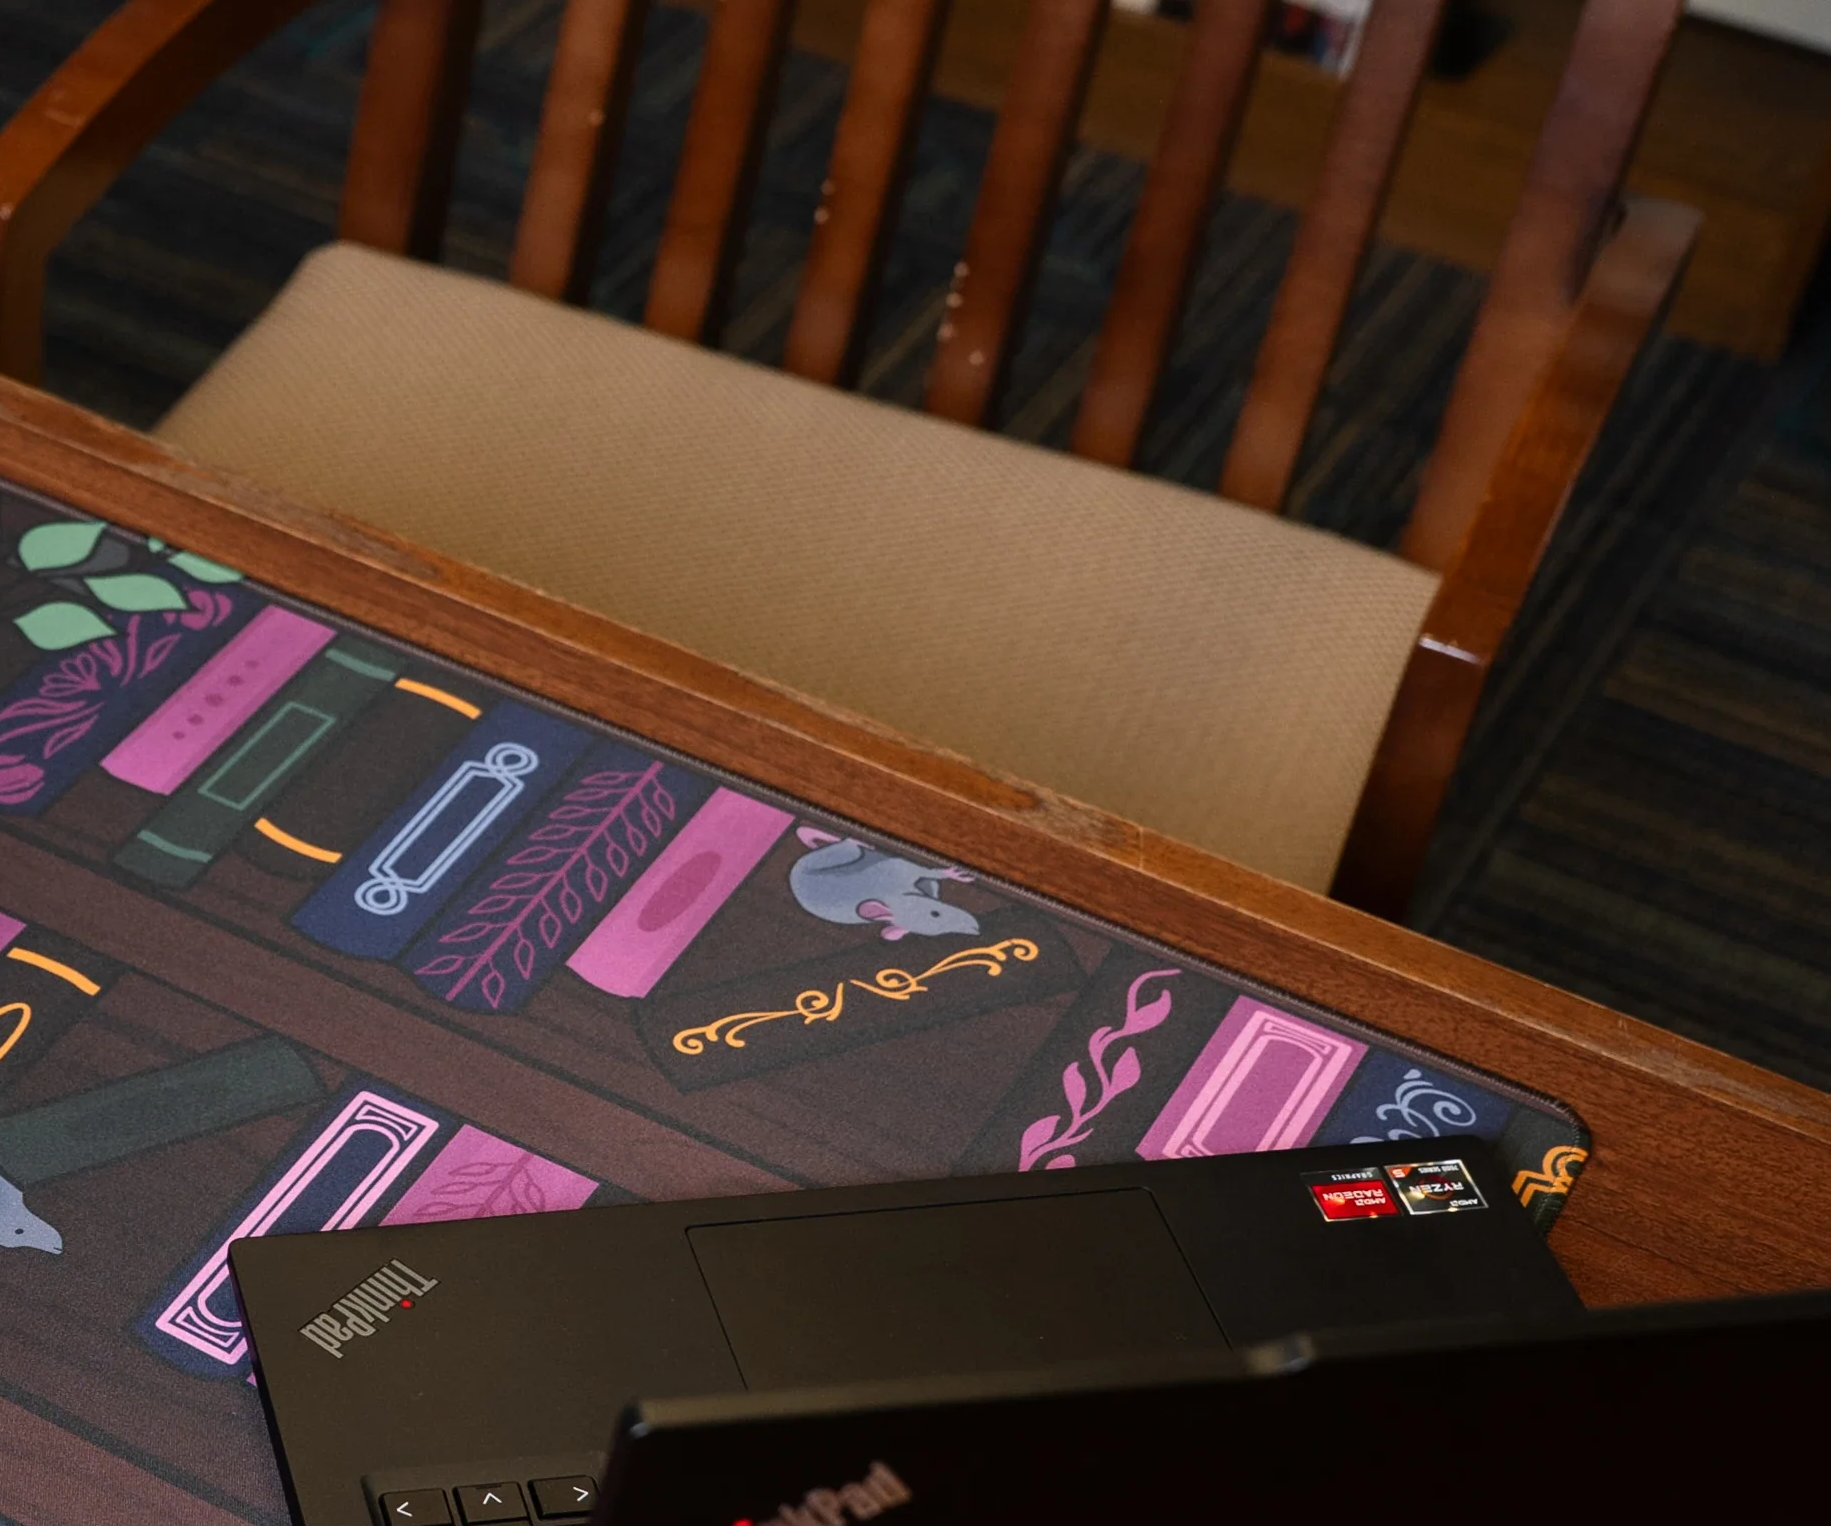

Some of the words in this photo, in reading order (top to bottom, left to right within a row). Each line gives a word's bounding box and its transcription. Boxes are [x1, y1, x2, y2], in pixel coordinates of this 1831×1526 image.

[1419, 1166, 1442, 1174] SERIES
[1331, 1171, 1373, 1181] GRAPHICS
[1409, 1180, 1464, 1194] RYZEN
[1322, 1188, 1384, 1201] RADEON
[1357, 1197, 1386, 1207] AMD
[1453, 1198, 1478, 1207] AMD
[299, 1258, 440, 1359] ThinkPad
